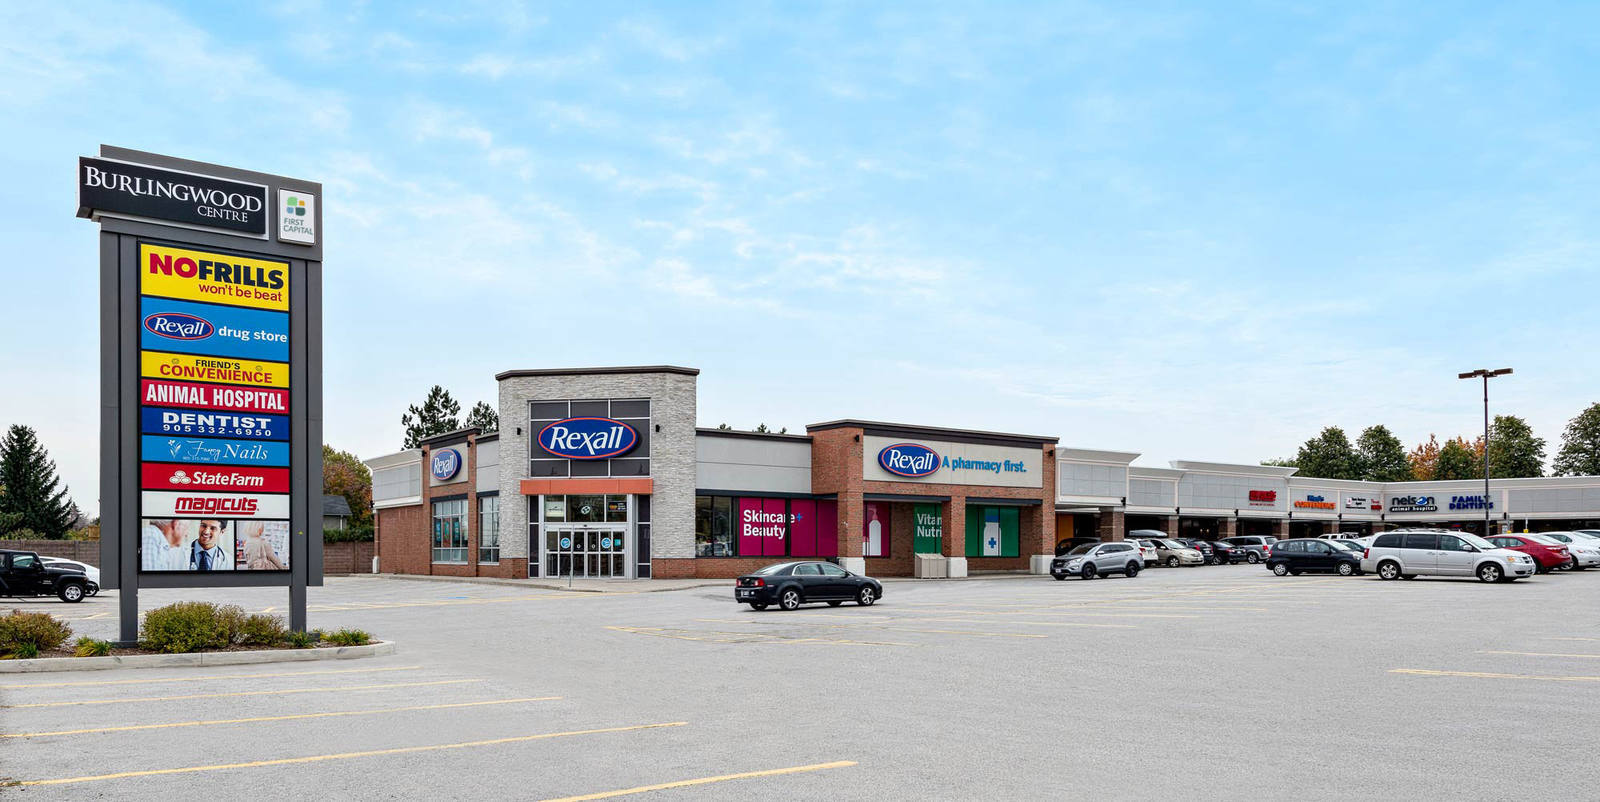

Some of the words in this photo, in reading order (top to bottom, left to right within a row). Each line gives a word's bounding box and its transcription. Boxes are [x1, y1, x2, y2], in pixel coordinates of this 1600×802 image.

[197, 205, 249, 223] CENTRE
[284, 218, 305, 227] FIRST
[283, 224, 314, 236] CAPITAL
[199, 283, 234, 297] won't
[235, 286, 252, 299] be
[253, 288, 283, 303] beat
[154, 316, 206, 337] Rexall
[218, 325, 251, 342] drug
[253, 329, 288, 343] store
[195, 359, 241, 370] FRIEND'S
[159, 364, 273, 384] CONVENIENCE
[146, 383, 209, 406] ANIMAL
[213, 388, 286, 411] HOSPITAL
[162, 412, 272, 429] DENTIST
[163, 424, 192, 433] 905
[198, 426, 272, 437] 332-6950
[549, 426, 625, 456] Rexall
[223, 443, 269, 461] Nails
[433, 455, 455, 477] Rexall
[888, 449, 935, 474] Rexall
[941, 456, 952, 468] A
[952, 458, 1001, 473] pharmacy
[1003, 460, 1027, 474] first.
[175, 497, 257, 515] magicuts
[1392, 495, 1435, 506] nelson
[1449, 502, 1494, 510] DENTISTS
[743, 523, 786, 540] Beauty
